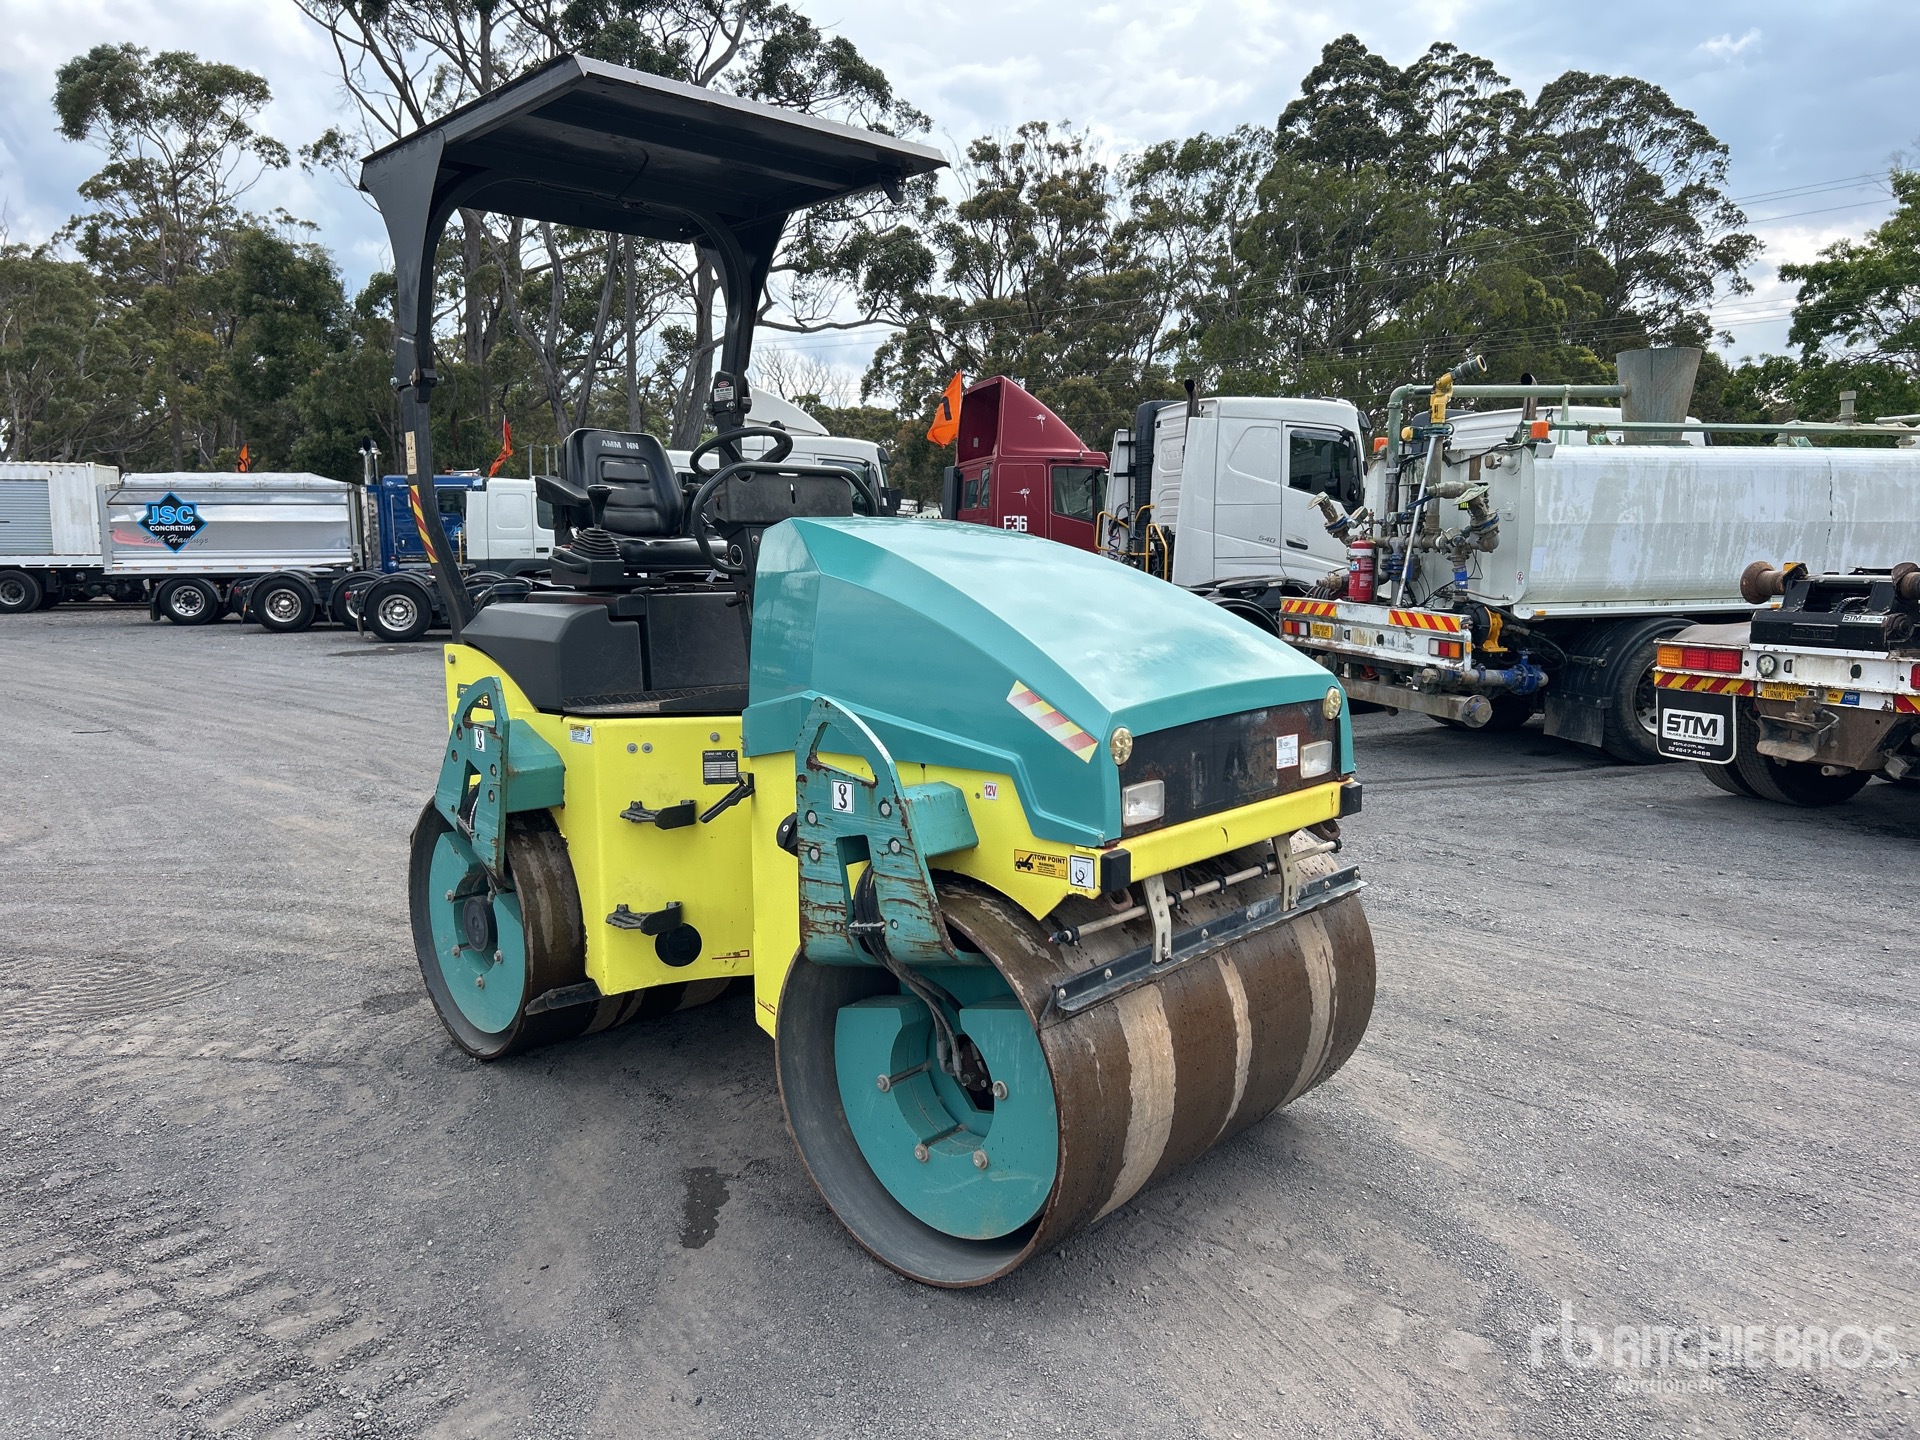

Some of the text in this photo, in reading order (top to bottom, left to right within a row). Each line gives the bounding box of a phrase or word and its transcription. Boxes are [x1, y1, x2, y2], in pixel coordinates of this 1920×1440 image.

[148, 505, 194, 525] JSC
[167, 533, 209, 546] Haulage
[1666, 713, 1718, 738] STM
[985, 784, 997, 797] 12V
[1048, 856, 1066, 865] POINT
